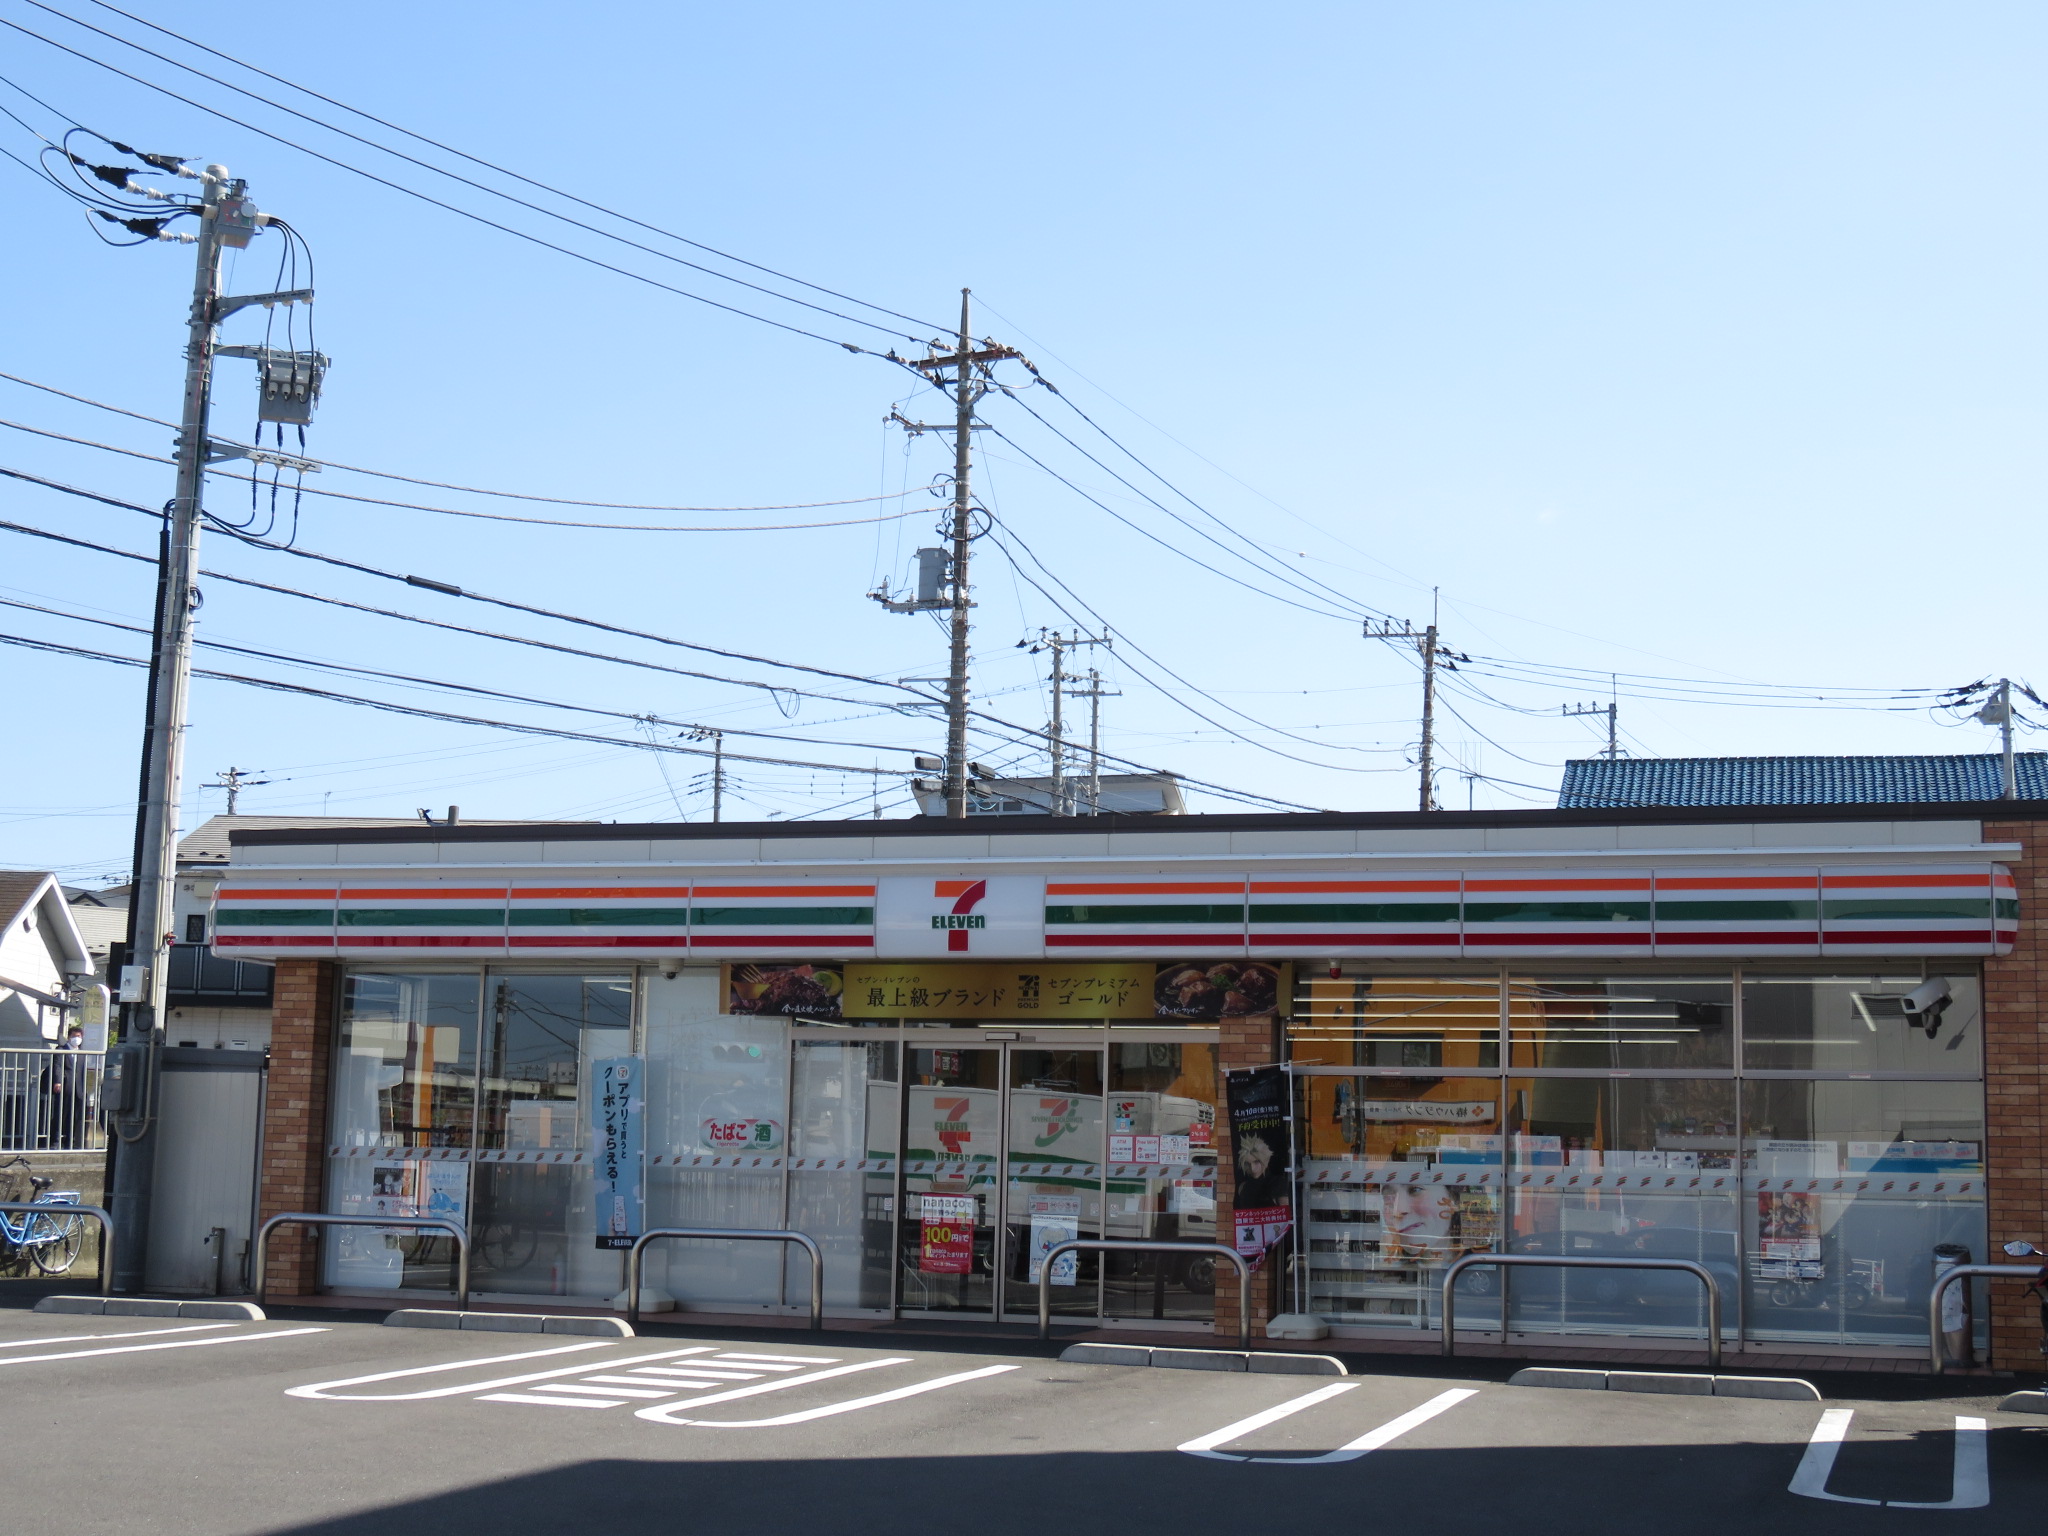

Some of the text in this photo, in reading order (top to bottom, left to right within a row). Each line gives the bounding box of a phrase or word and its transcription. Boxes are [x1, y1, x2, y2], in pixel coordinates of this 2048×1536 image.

[1048, 978, 1140, 989] セブンプレミアム
[867, 987, 1006, 1007] 最上級ブランド
[1058, 990, 1129, 1007] ゴールド
[618, 1082, 630, 1159] アプリで買うと
[709, 1122, 747, 1141] たばこ
[754, 1123, 772, 1142] 酒
